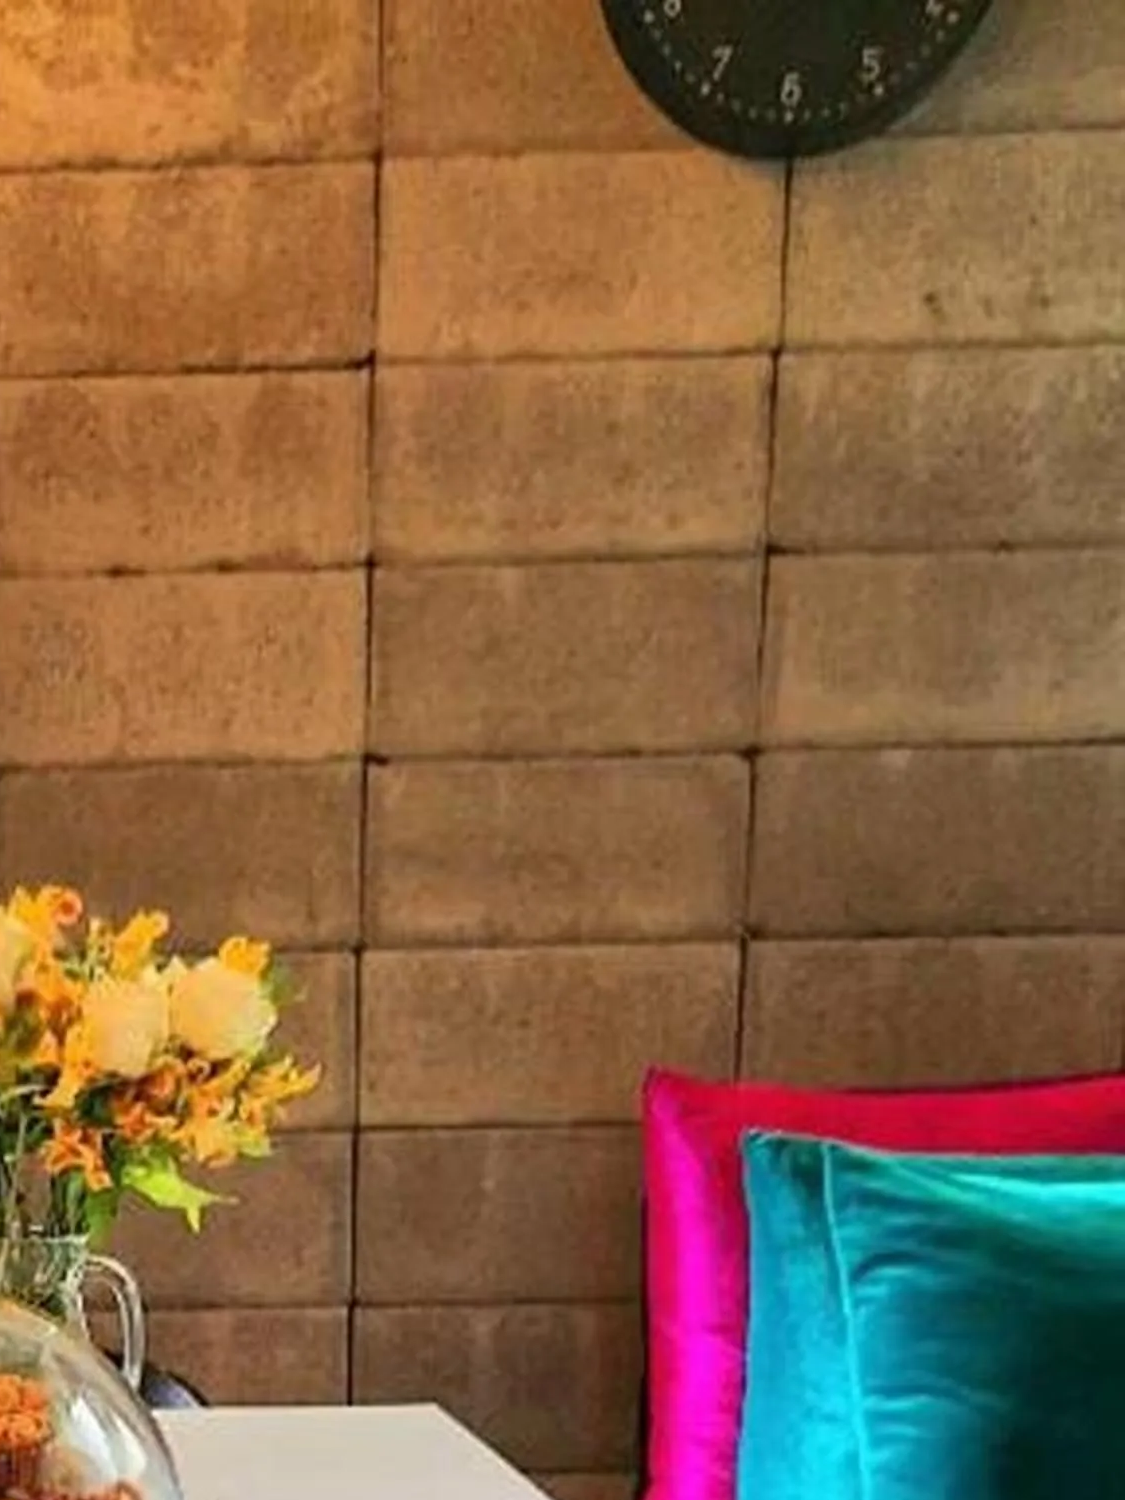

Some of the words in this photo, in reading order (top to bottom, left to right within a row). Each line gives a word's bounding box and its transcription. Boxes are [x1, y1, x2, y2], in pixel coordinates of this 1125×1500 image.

[712, 45, 733, 81] 7
[861, 48, 882, 83] 5
[780, 71, 802, 107] 6
